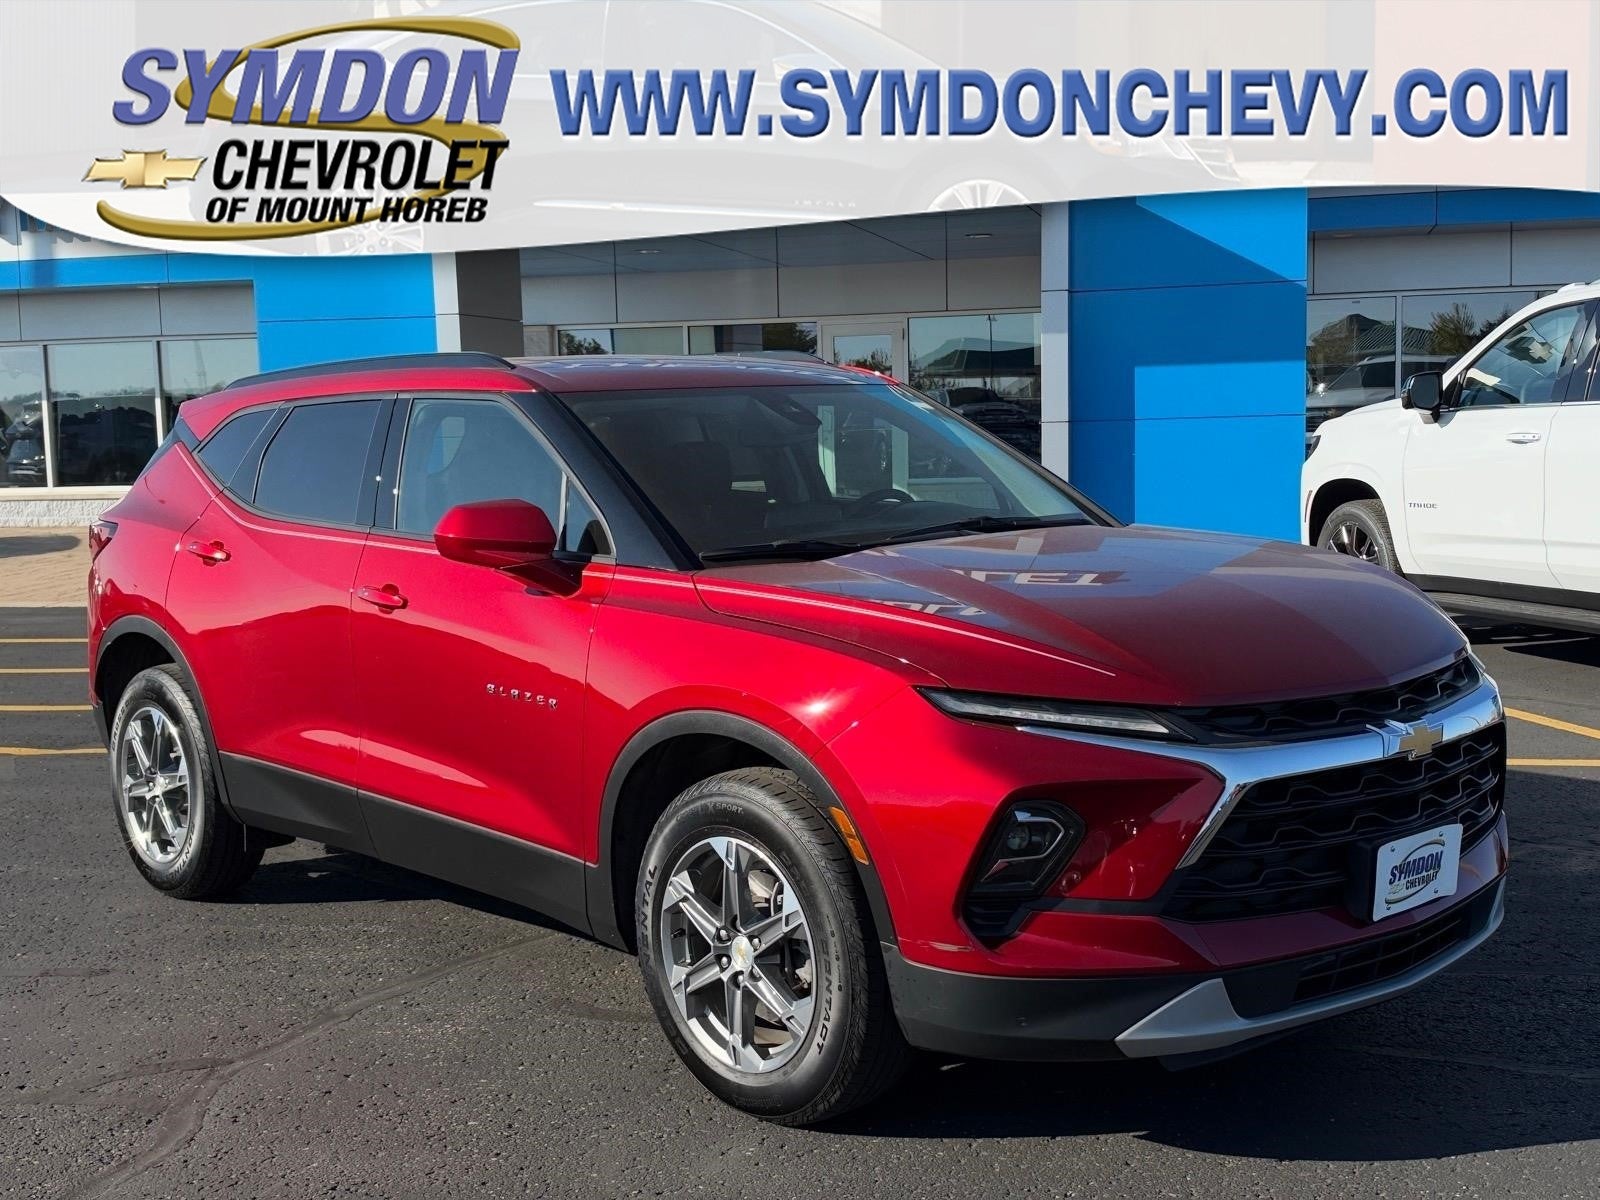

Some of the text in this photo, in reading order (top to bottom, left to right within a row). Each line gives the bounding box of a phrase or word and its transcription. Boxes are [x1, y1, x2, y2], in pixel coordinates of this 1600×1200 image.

[486, 683, 557, 709] BLAZER
[1388, 850, 1444, 886] SYMDON
[1405, 870, 1440, 891] CHEVROLET
